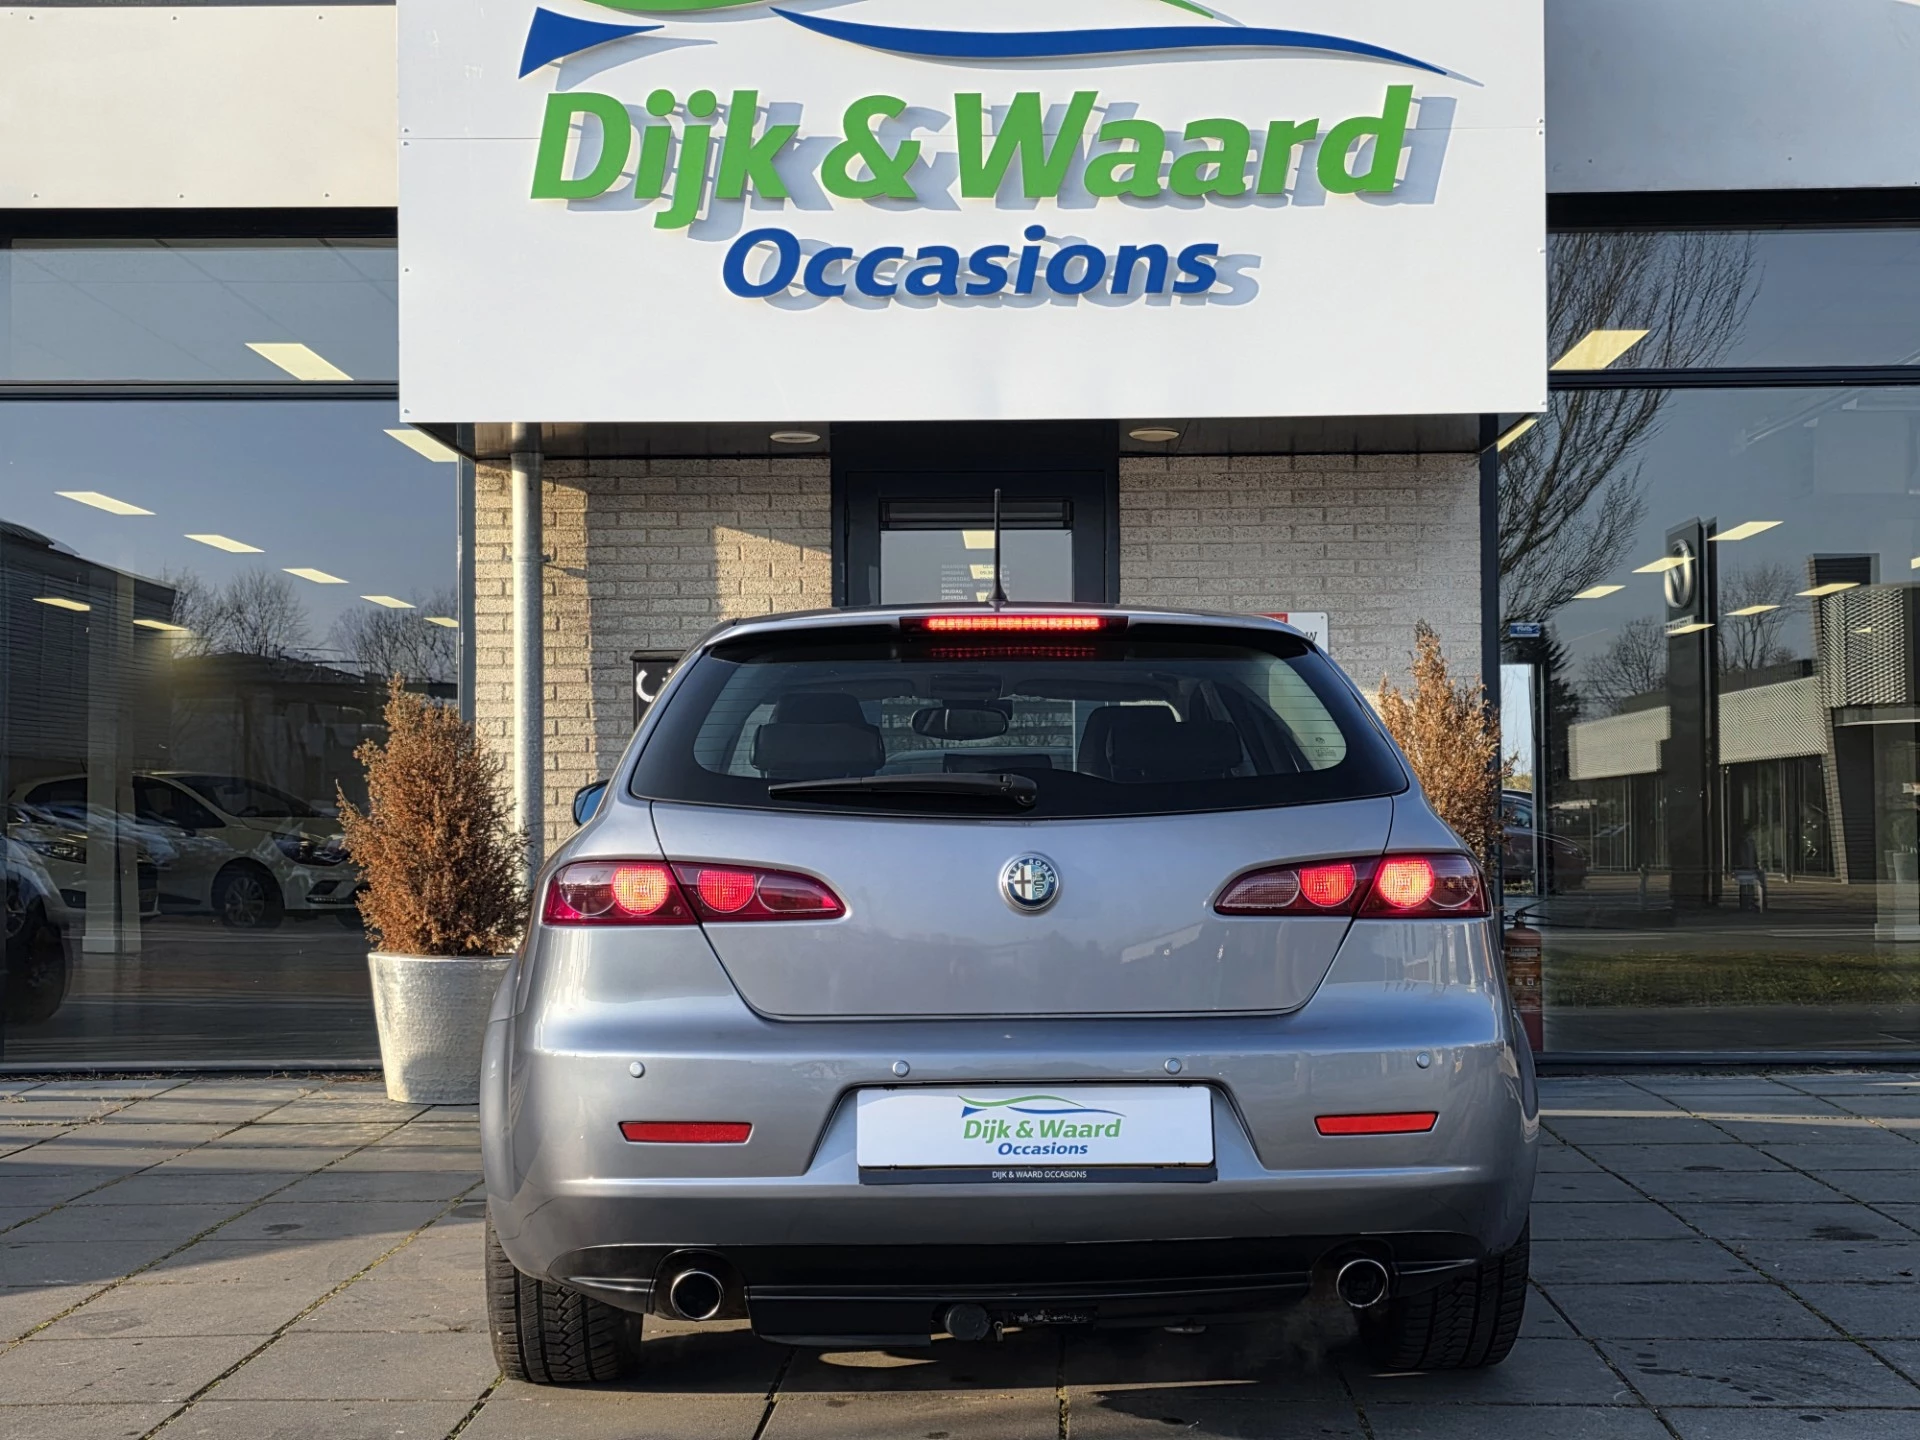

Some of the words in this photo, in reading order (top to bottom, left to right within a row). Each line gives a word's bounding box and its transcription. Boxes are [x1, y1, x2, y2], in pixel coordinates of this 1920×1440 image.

[531, 89, 798, 230] Dijk
[821, 95, 921, 199] &
[955, 85, 1414, 198] Waard
[723, 225, 1219, 297] Occasions
[1008, 862, 1025, 884] ALFA
[1028, 858, 1055, 883] ROMEO
[963, 1119, 1011, 1144] Dijk
[1015, 1119, 1034, 1139] &
[1039, 1118, 1122, 1138] Waard
[997, 1142, 1088, 1156] Occasions
[992, 1171, 1007, 1179] DIJK
[1044, 1170, 1087, 1178] OCCASIONS
